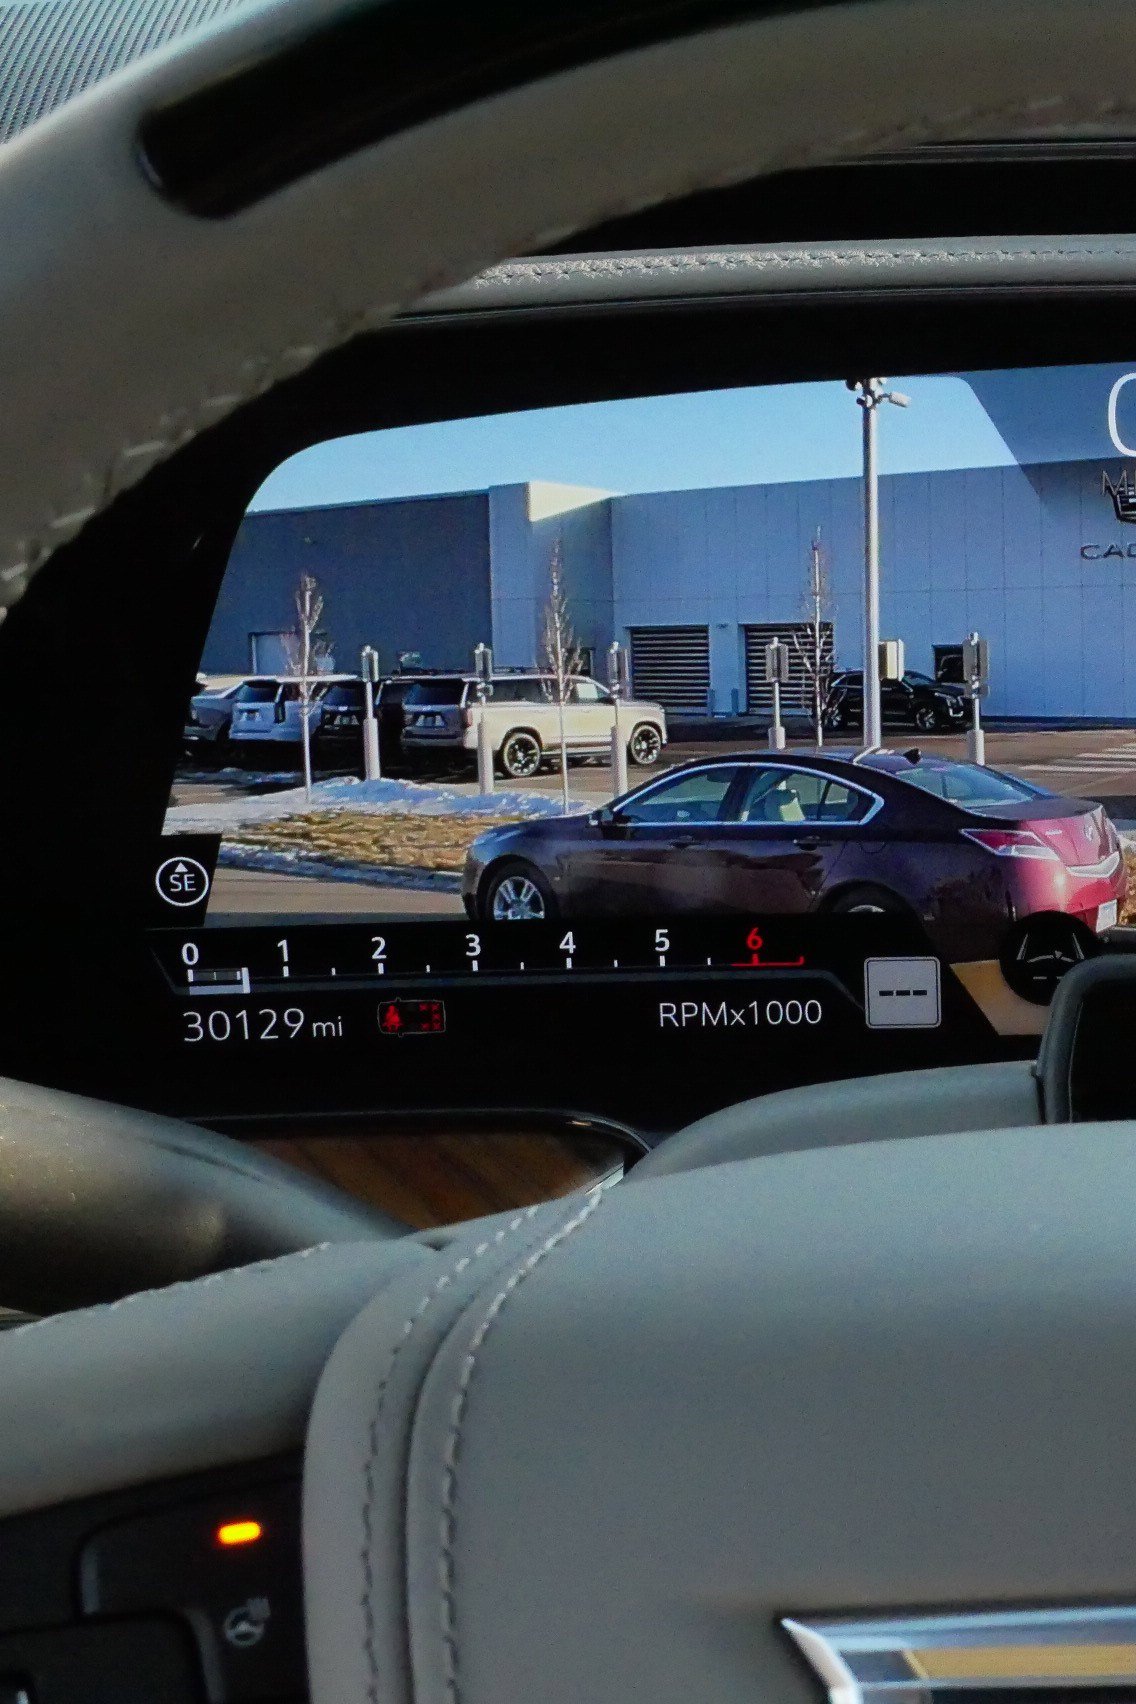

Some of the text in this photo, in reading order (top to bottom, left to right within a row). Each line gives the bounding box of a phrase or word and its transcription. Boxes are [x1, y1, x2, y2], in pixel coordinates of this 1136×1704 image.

[169, 870, 198, 892] SE
[181, 927, 763, 967] 0 1 2 3 4 5 6
[658, 999, 823, 1028] RPMx1000
